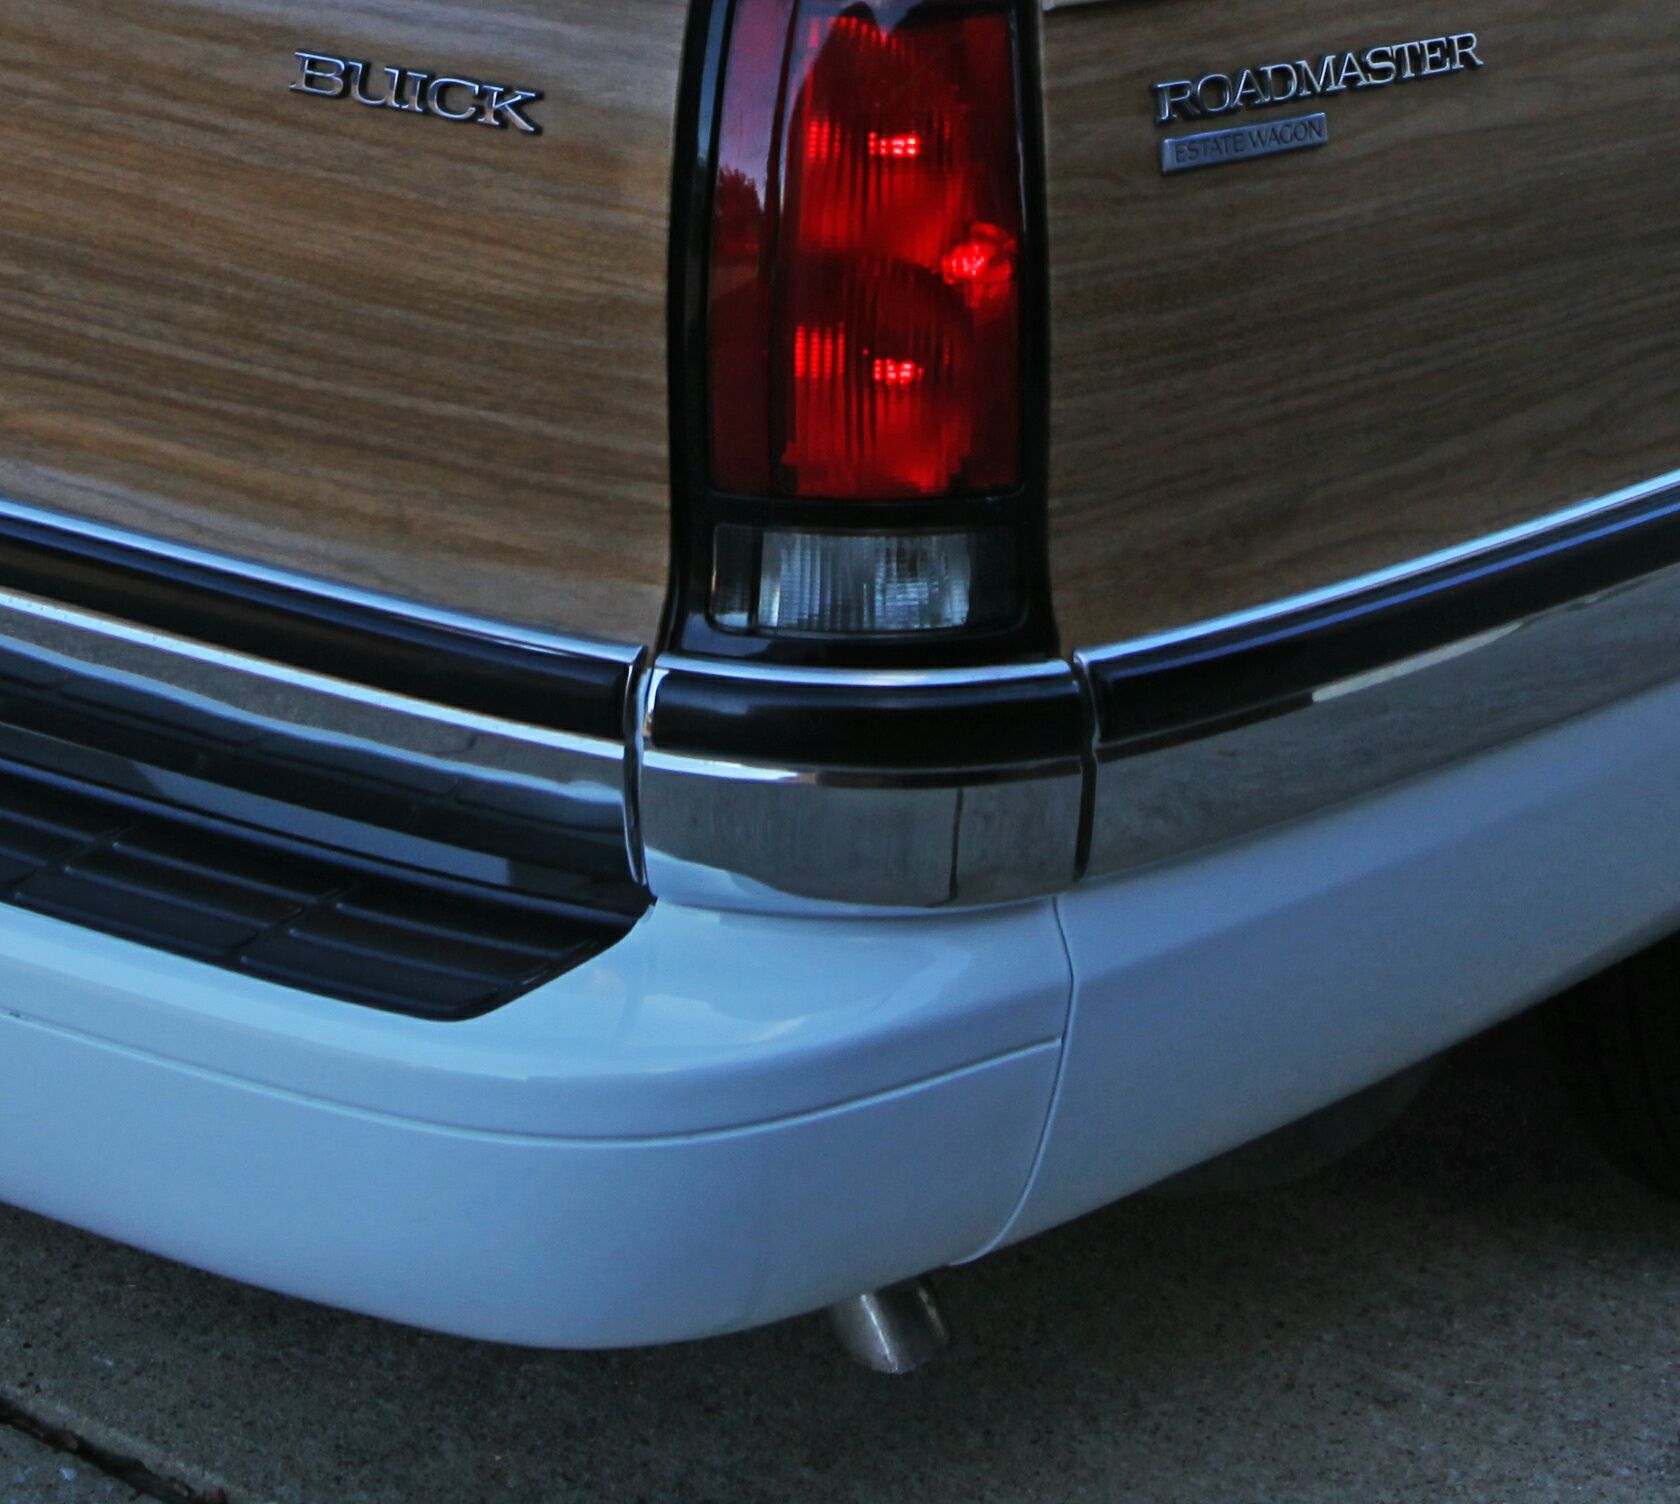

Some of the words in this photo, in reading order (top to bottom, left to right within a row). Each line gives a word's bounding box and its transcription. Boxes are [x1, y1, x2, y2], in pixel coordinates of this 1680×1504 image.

[288, 50, 544, 135] BUICK
[1152, 32, 1484, 125] ROADMASTER
[1175, 132, 1245, 164] ESTATE
[1248, 118, 1321, 149] WAGON
